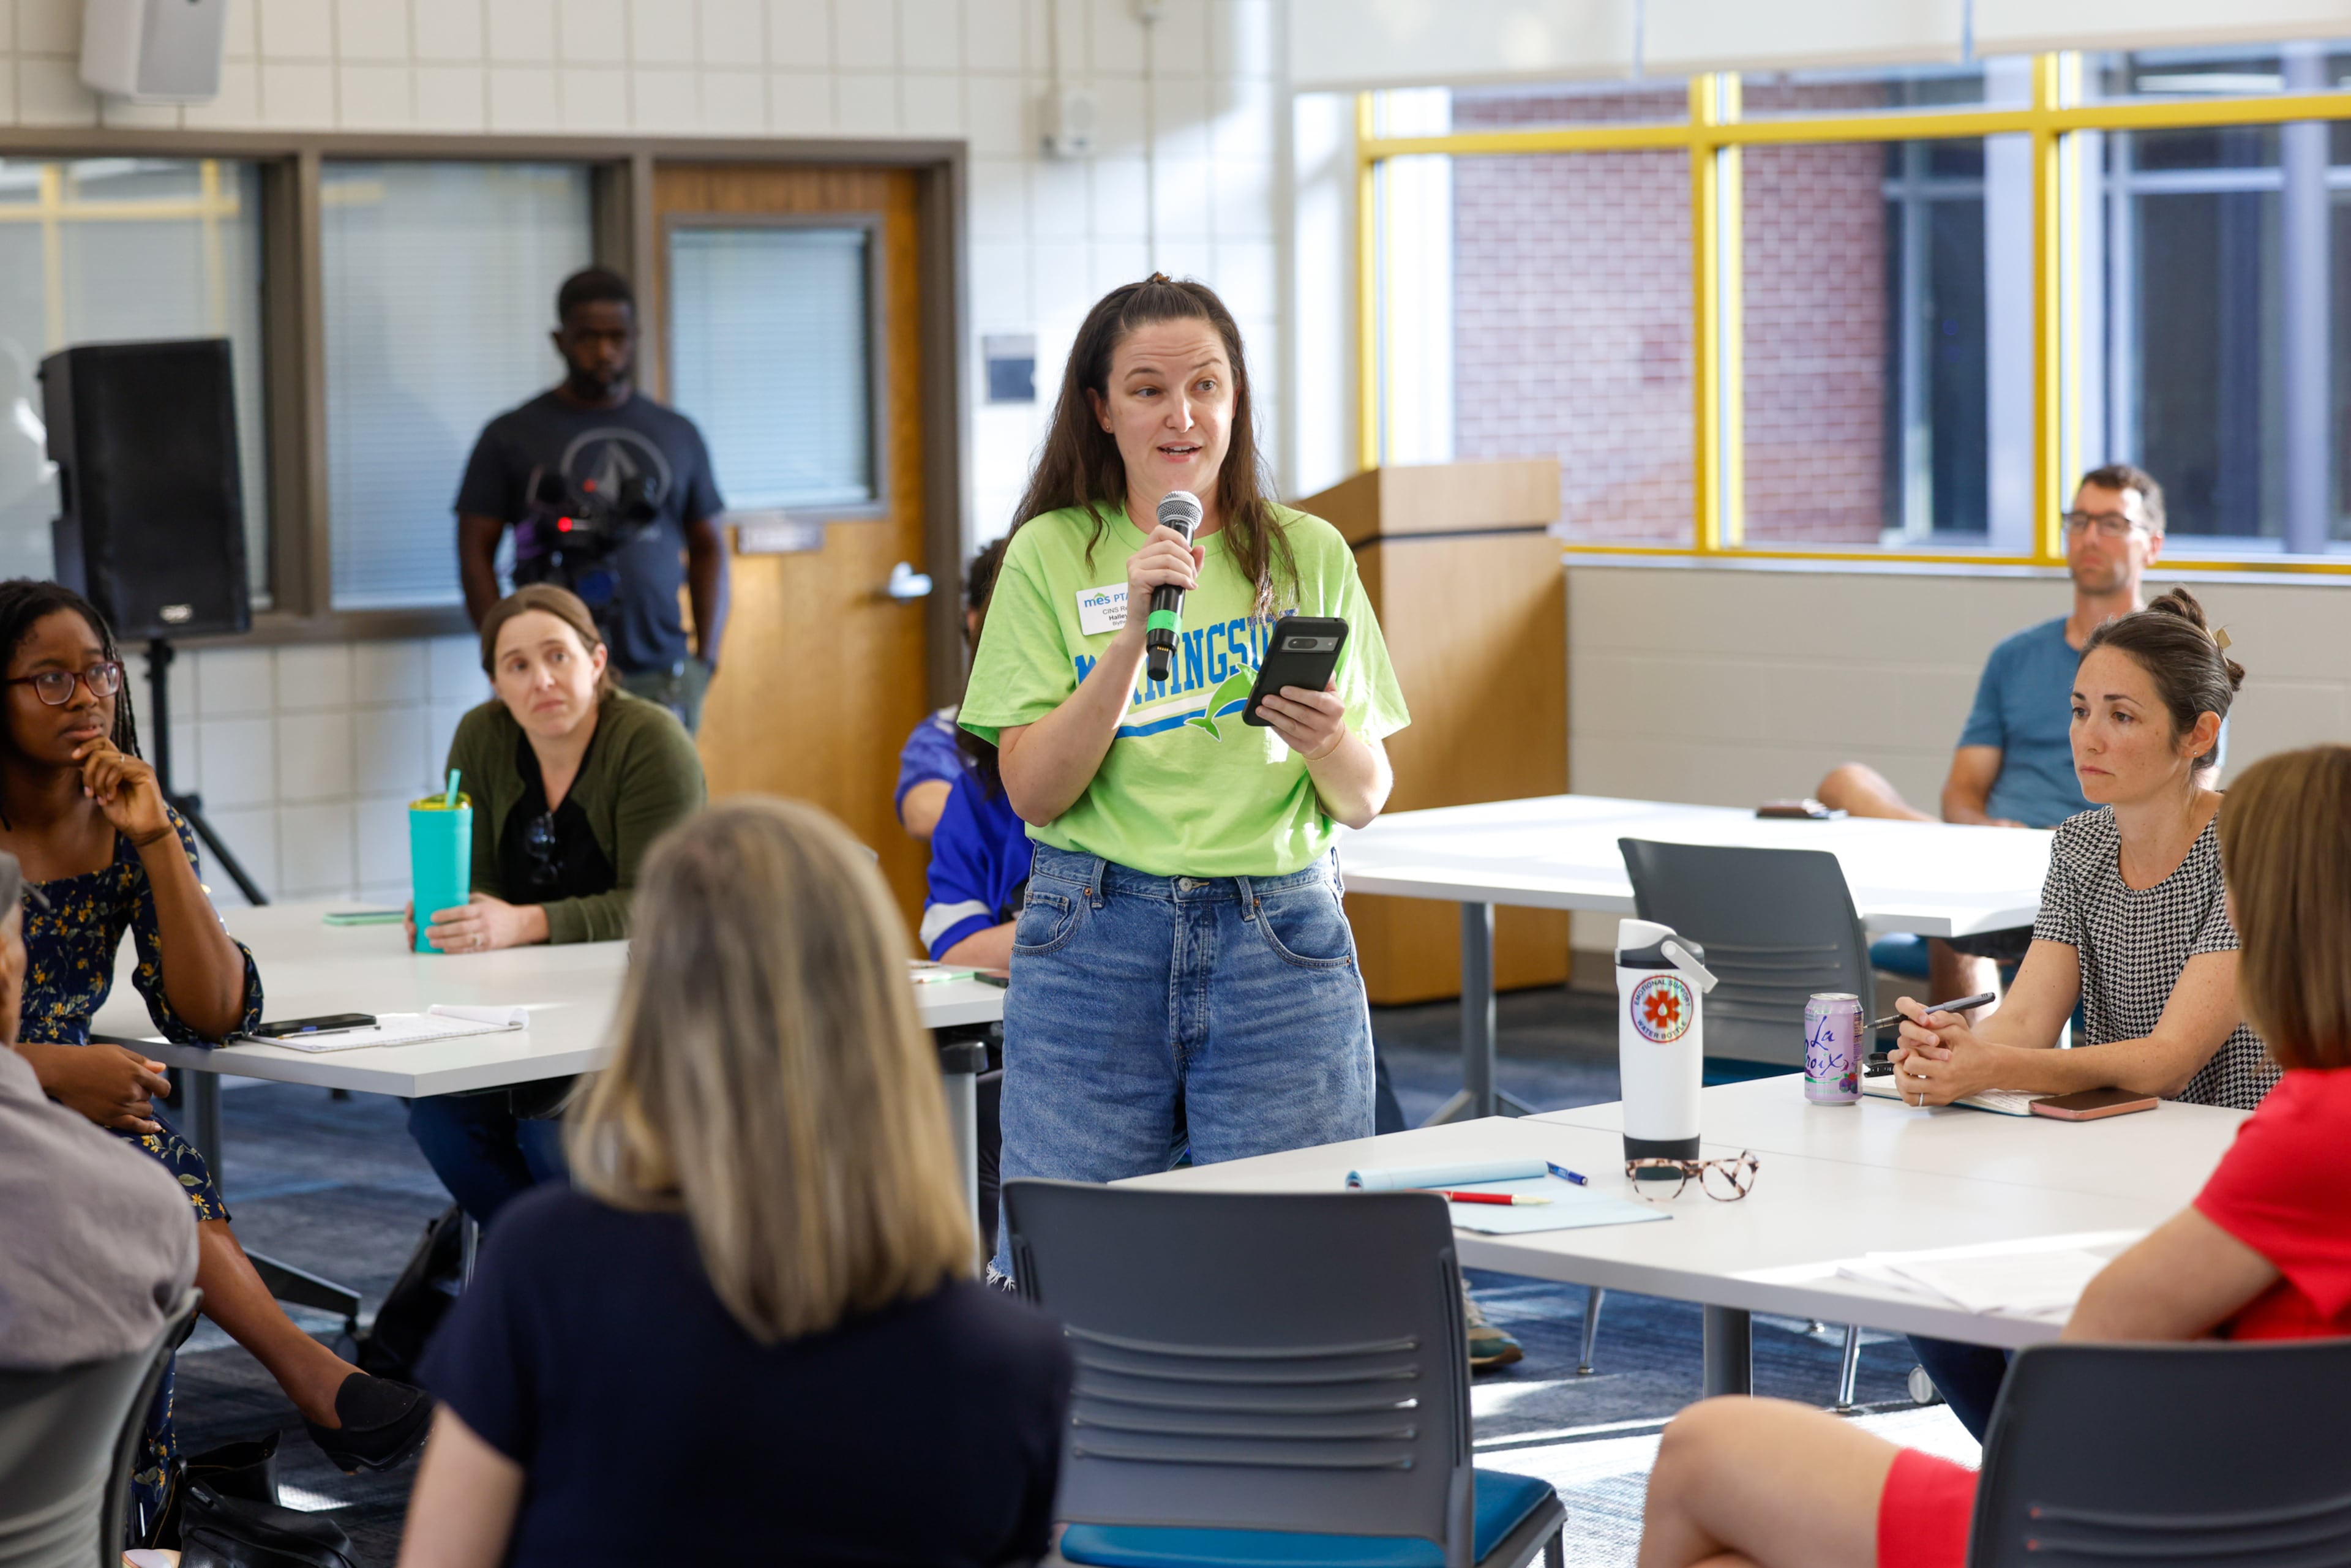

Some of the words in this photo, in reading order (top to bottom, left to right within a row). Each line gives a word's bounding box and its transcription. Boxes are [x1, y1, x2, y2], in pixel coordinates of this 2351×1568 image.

[1084, 596, 1111, 607] mes
[1114, 592, 1128, 602] PT
[1633, 979, 1667, 1006] EMOTIONAL
[1668, 980, 1690, 1007] SUPPORT
[1637, 1019, 1659, 1038] WATER
[1661, 1020, 1687, 1039] BOTTLE
[1810, 1015, 1835, 1051] La
